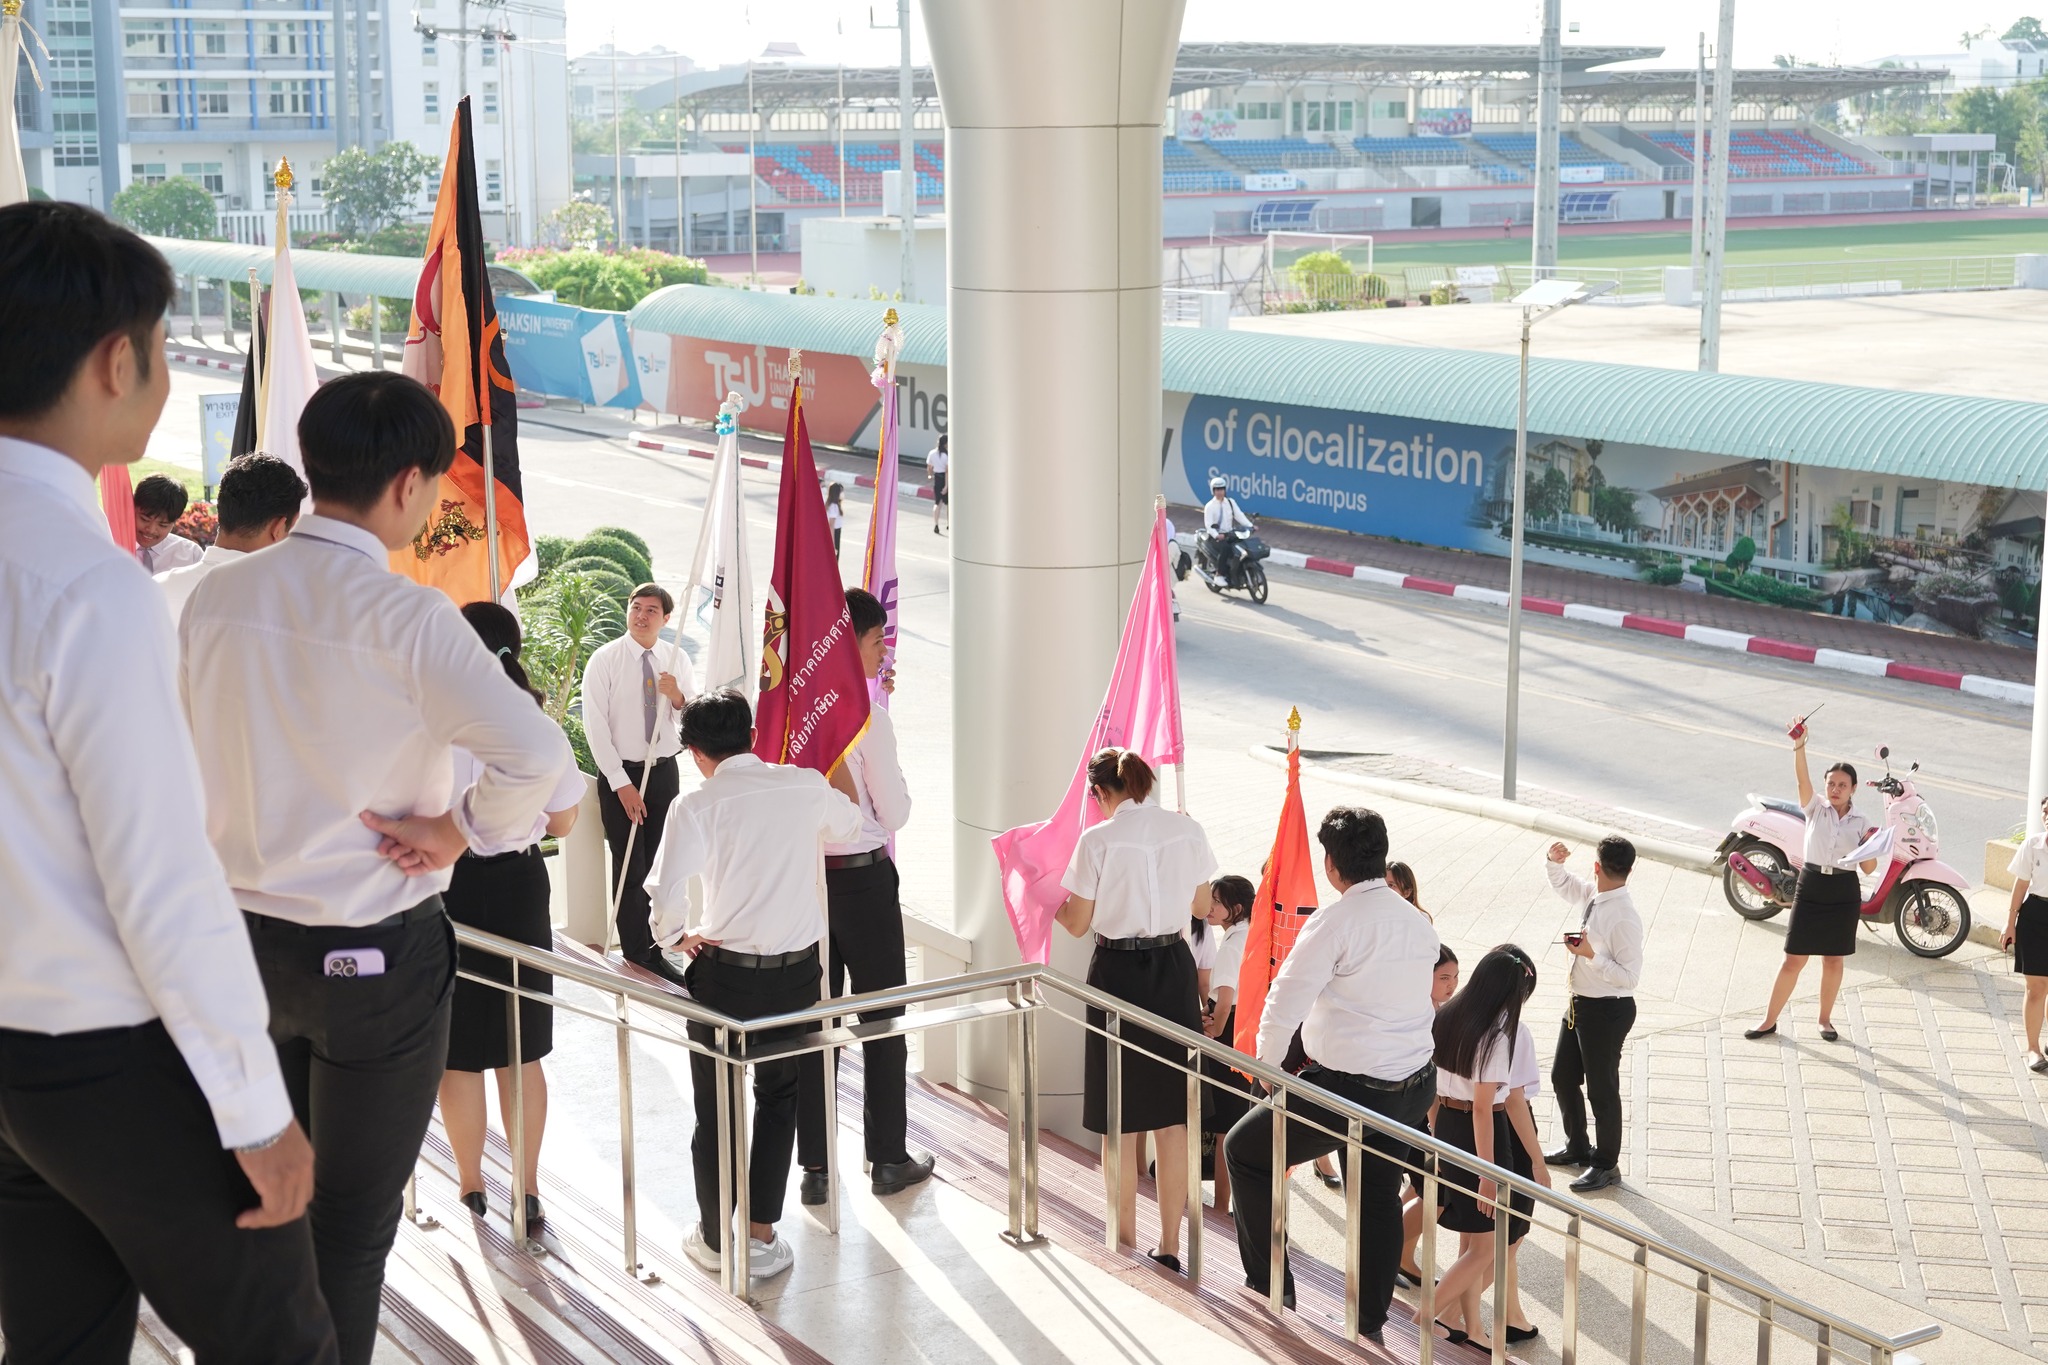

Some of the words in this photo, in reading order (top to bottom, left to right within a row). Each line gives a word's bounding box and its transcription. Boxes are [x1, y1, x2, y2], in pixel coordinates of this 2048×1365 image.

[495, 311, 541, 335] THAKSIN
[704, 345, 767, 412] TSU
[205, 401, 239, 412] ทางออ
[216, 411, 235, 419] EXIT
[1204, 408, 1238, 452] of
[1246, 413, 1483, 487] Glocalization
[1207, 466, 1287, 500] Songkhla
[1291, 479, 1368, 513] Campus
